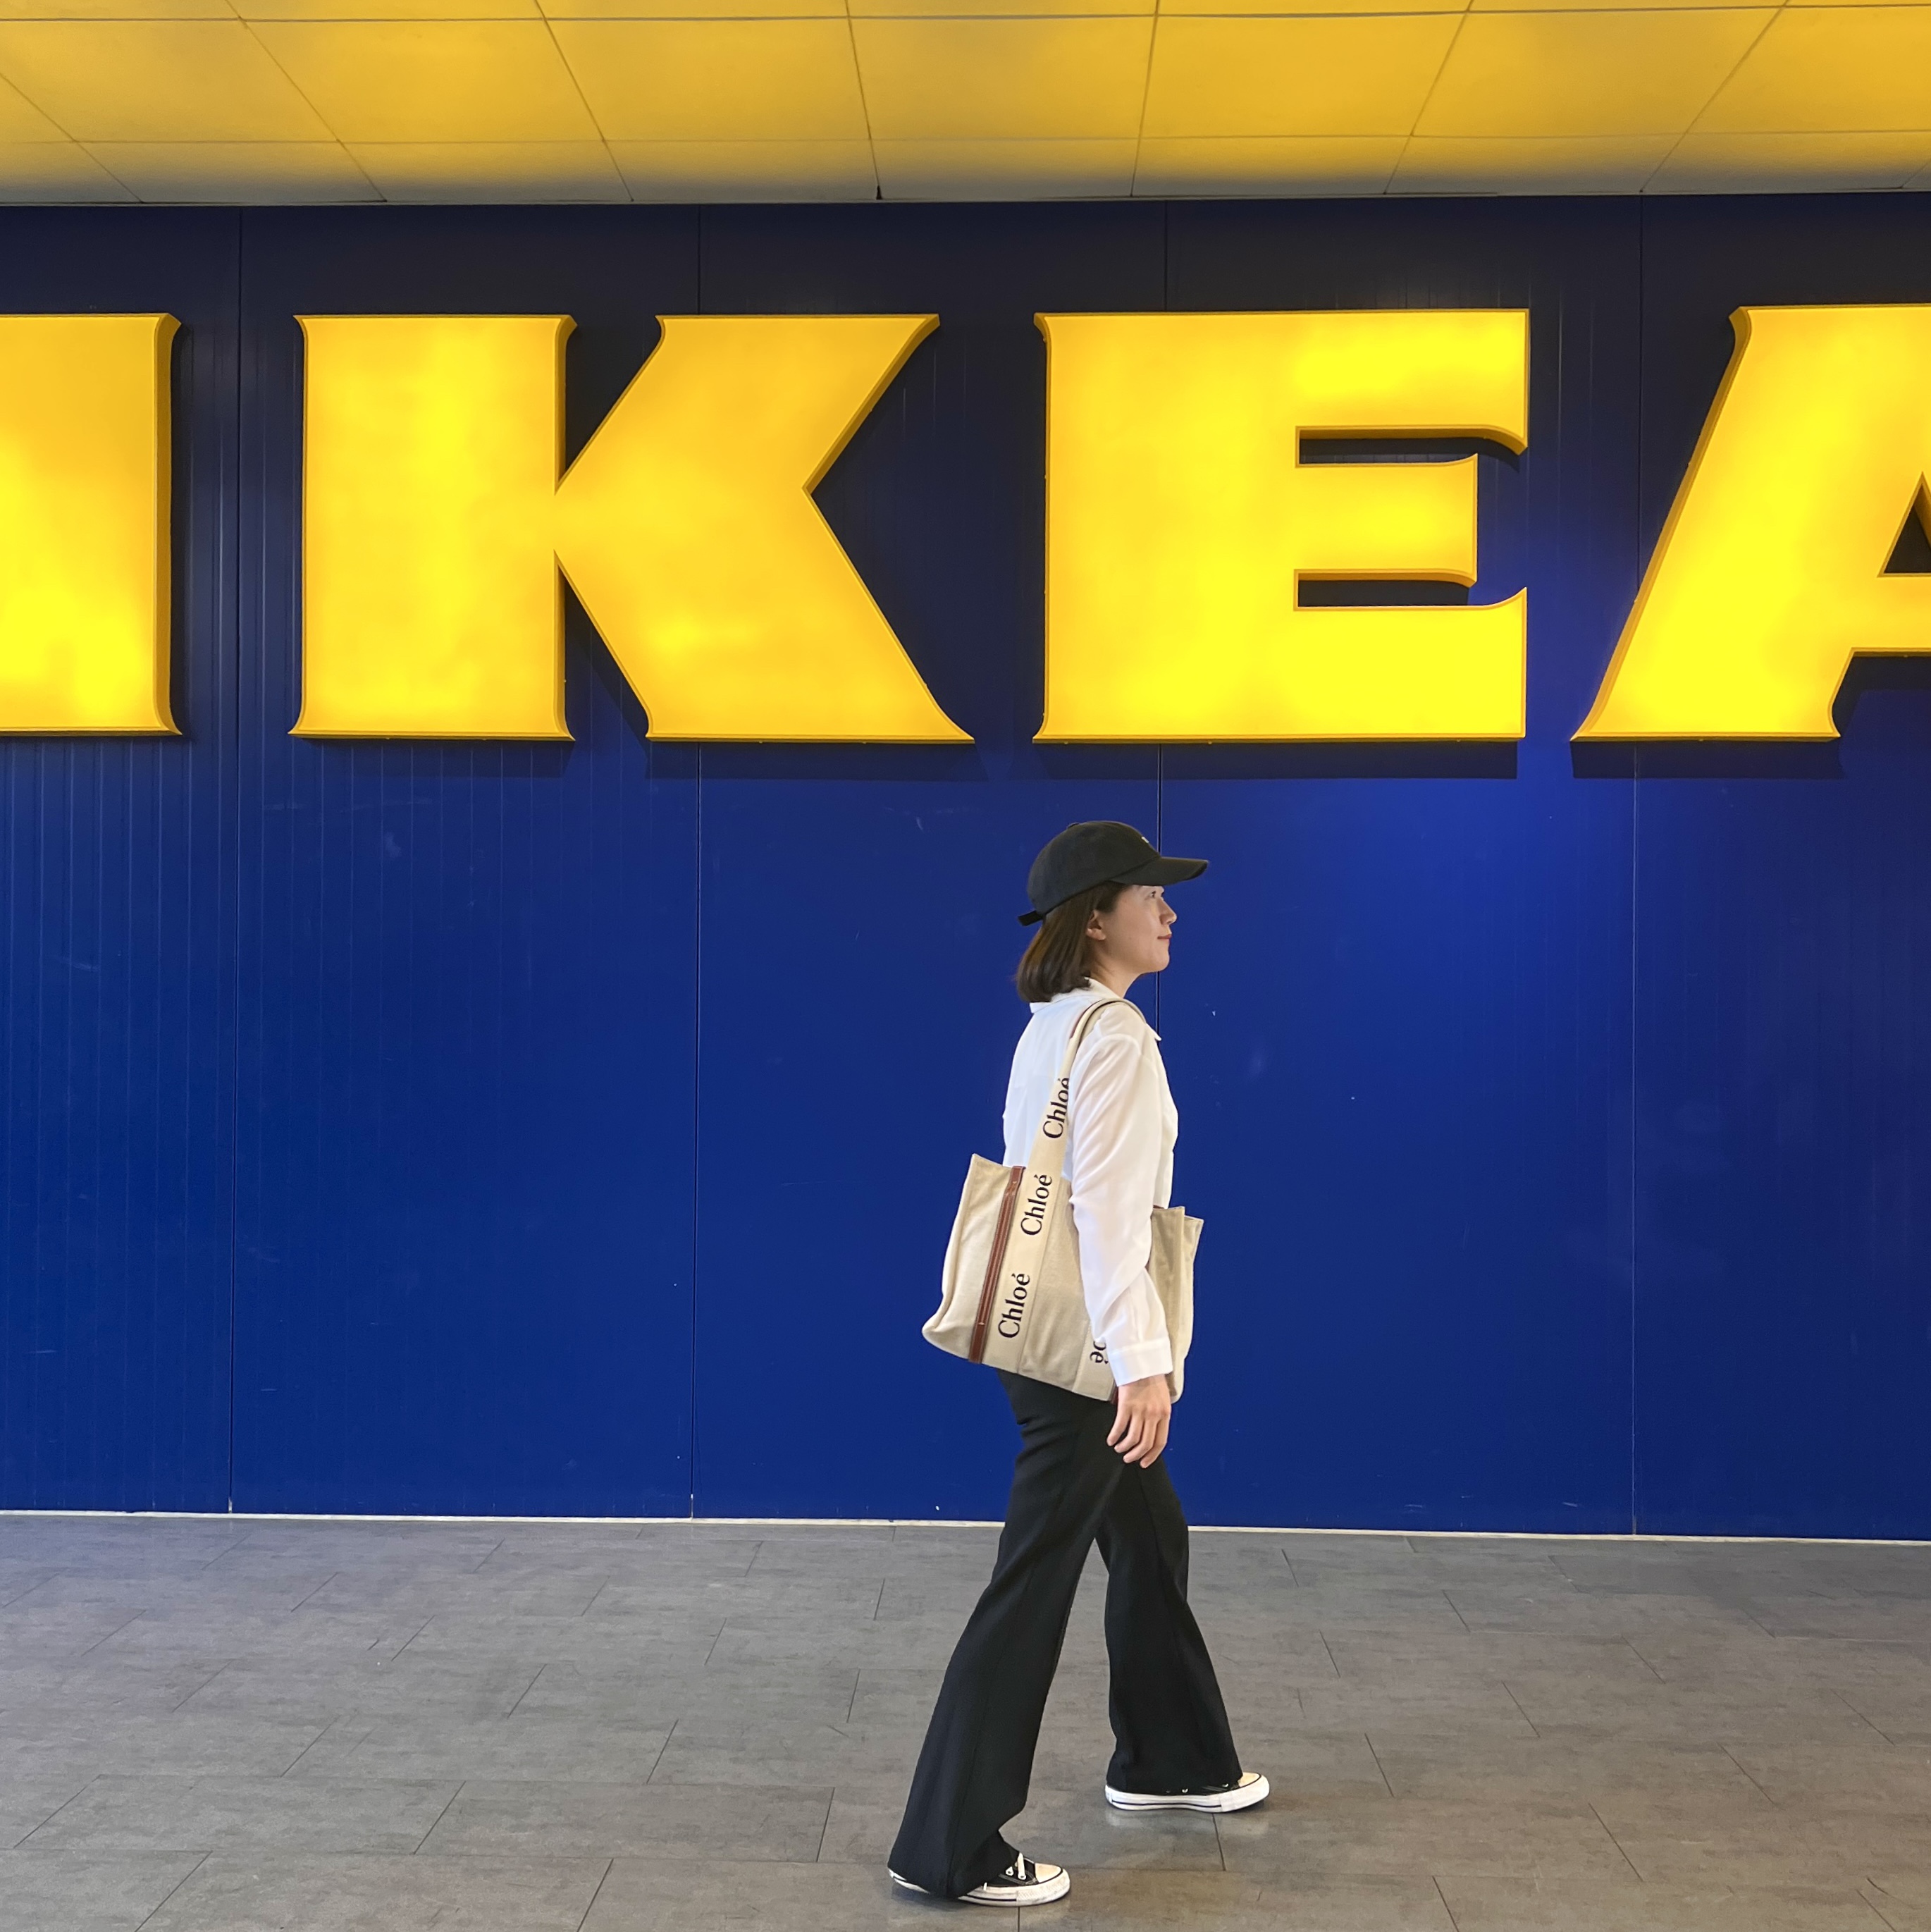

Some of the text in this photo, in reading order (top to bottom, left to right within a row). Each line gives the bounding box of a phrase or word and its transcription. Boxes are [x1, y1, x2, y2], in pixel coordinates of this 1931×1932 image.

[0, 303, 1931, 744] IKEA
[1020, 1174, 1052, 1236] Chloé
[998, 1273, 1031, 1339] Chloé
